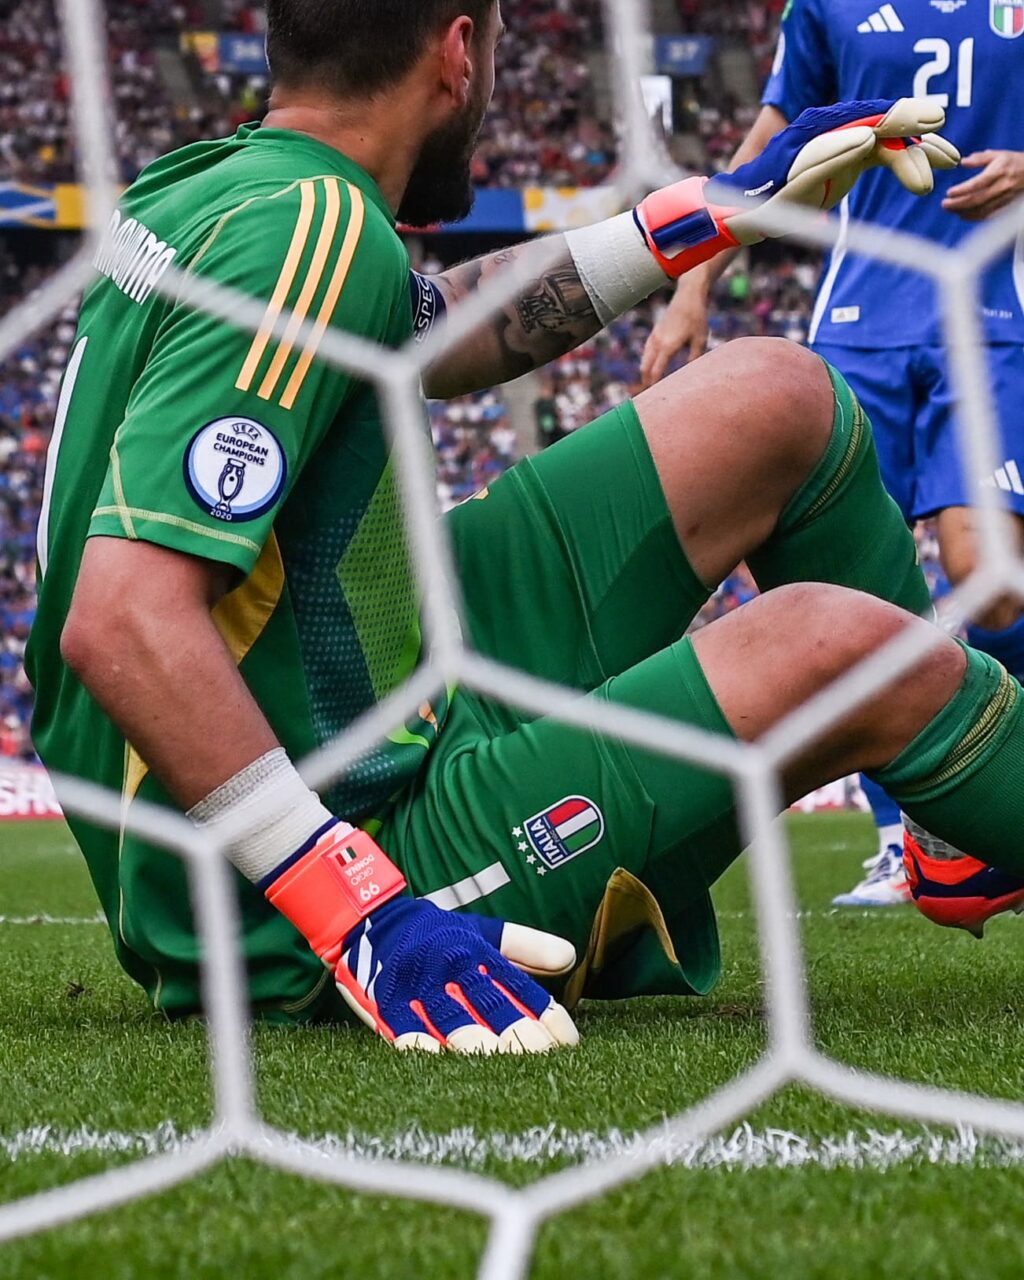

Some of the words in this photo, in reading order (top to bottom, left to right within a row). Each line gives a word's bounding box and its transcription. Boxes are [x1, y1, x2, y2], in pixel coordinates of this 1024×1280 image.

[912, 37, 974, 108] 21
[233, 423, 260, 441] UEFA
[212, 442, 267, 467] CHAMPIONS
[215, 432, 270, 458] EUROPEAN
[209, 507, 233, 521] 2020
[530, 817, 565, 865] ITALIA
